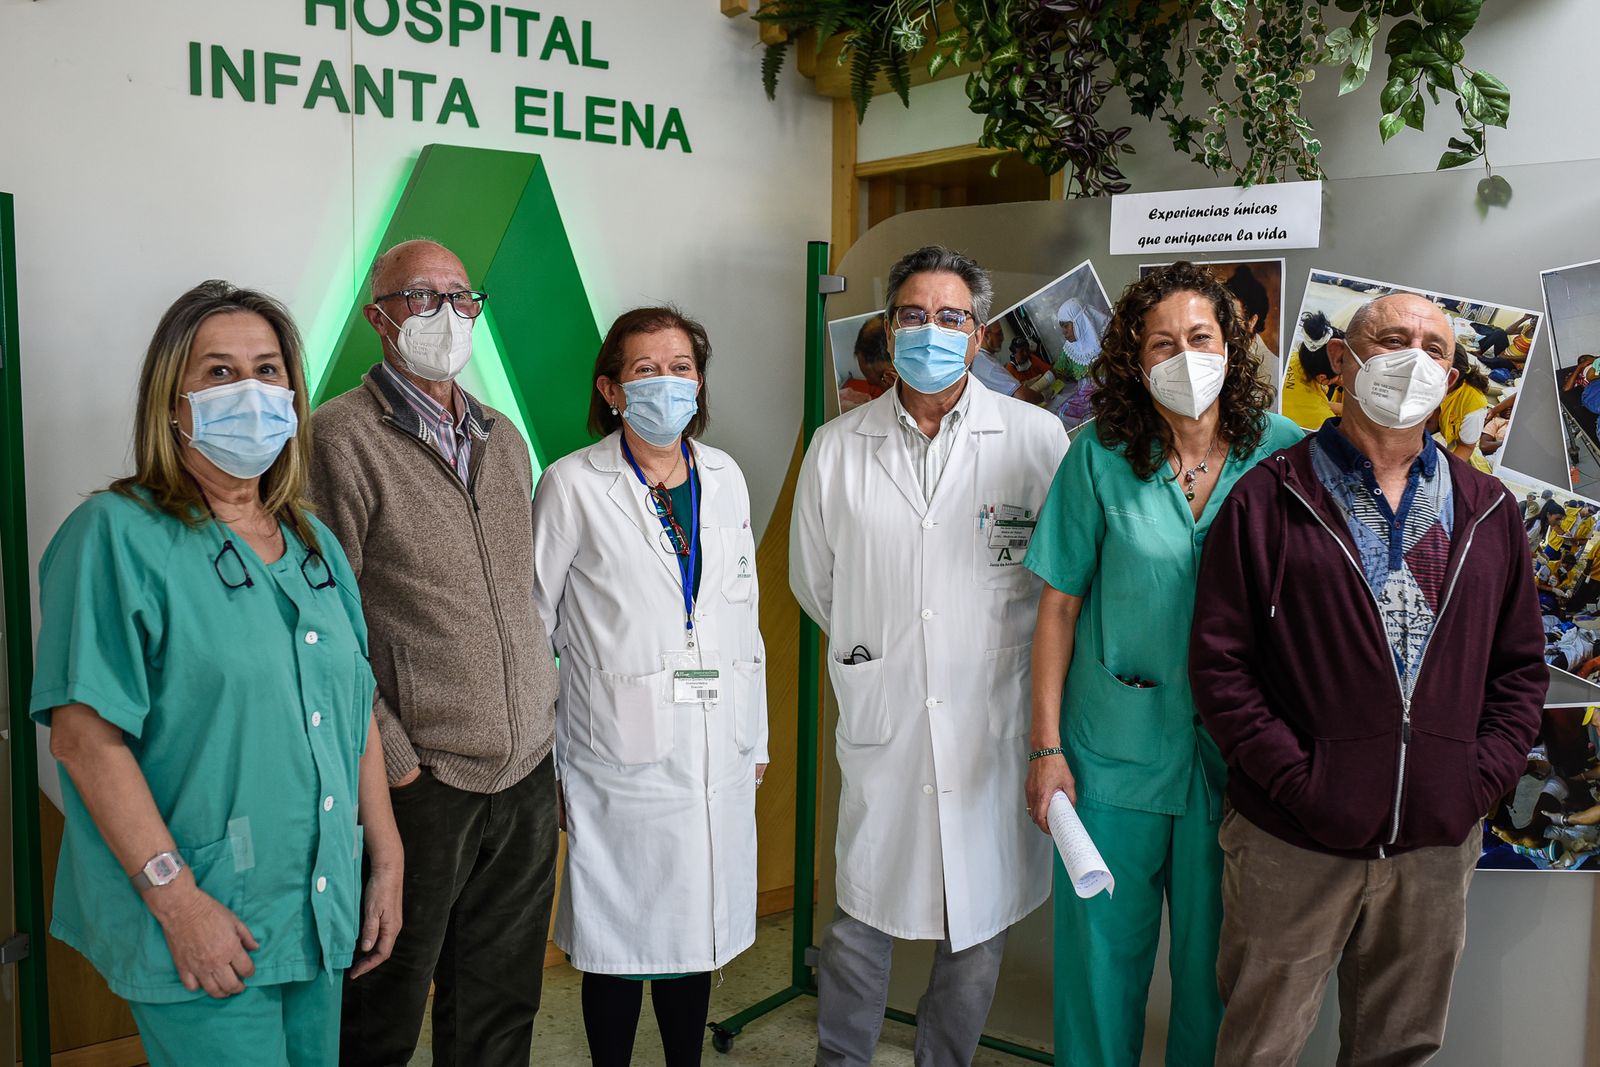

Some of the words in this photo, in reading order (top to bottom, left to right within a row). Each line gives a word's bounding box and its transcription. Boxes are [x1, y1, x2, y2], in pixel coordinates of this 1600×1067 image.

[305, 0, 609, 69] HOSPITAL
[190, 42, 480, 128] INFANTA
[515, 86, 693, 153] ELENA
[1148, 205, 1229, 222] Experiencias
[1234, 202, 1278, 216] únicas
[1137, 236, 1160, 248] que
[1164, 231, 1232, 246] enriquecen
[1237, 229, 1253, 241] la
[1257, 227, 1288, 240] vida
